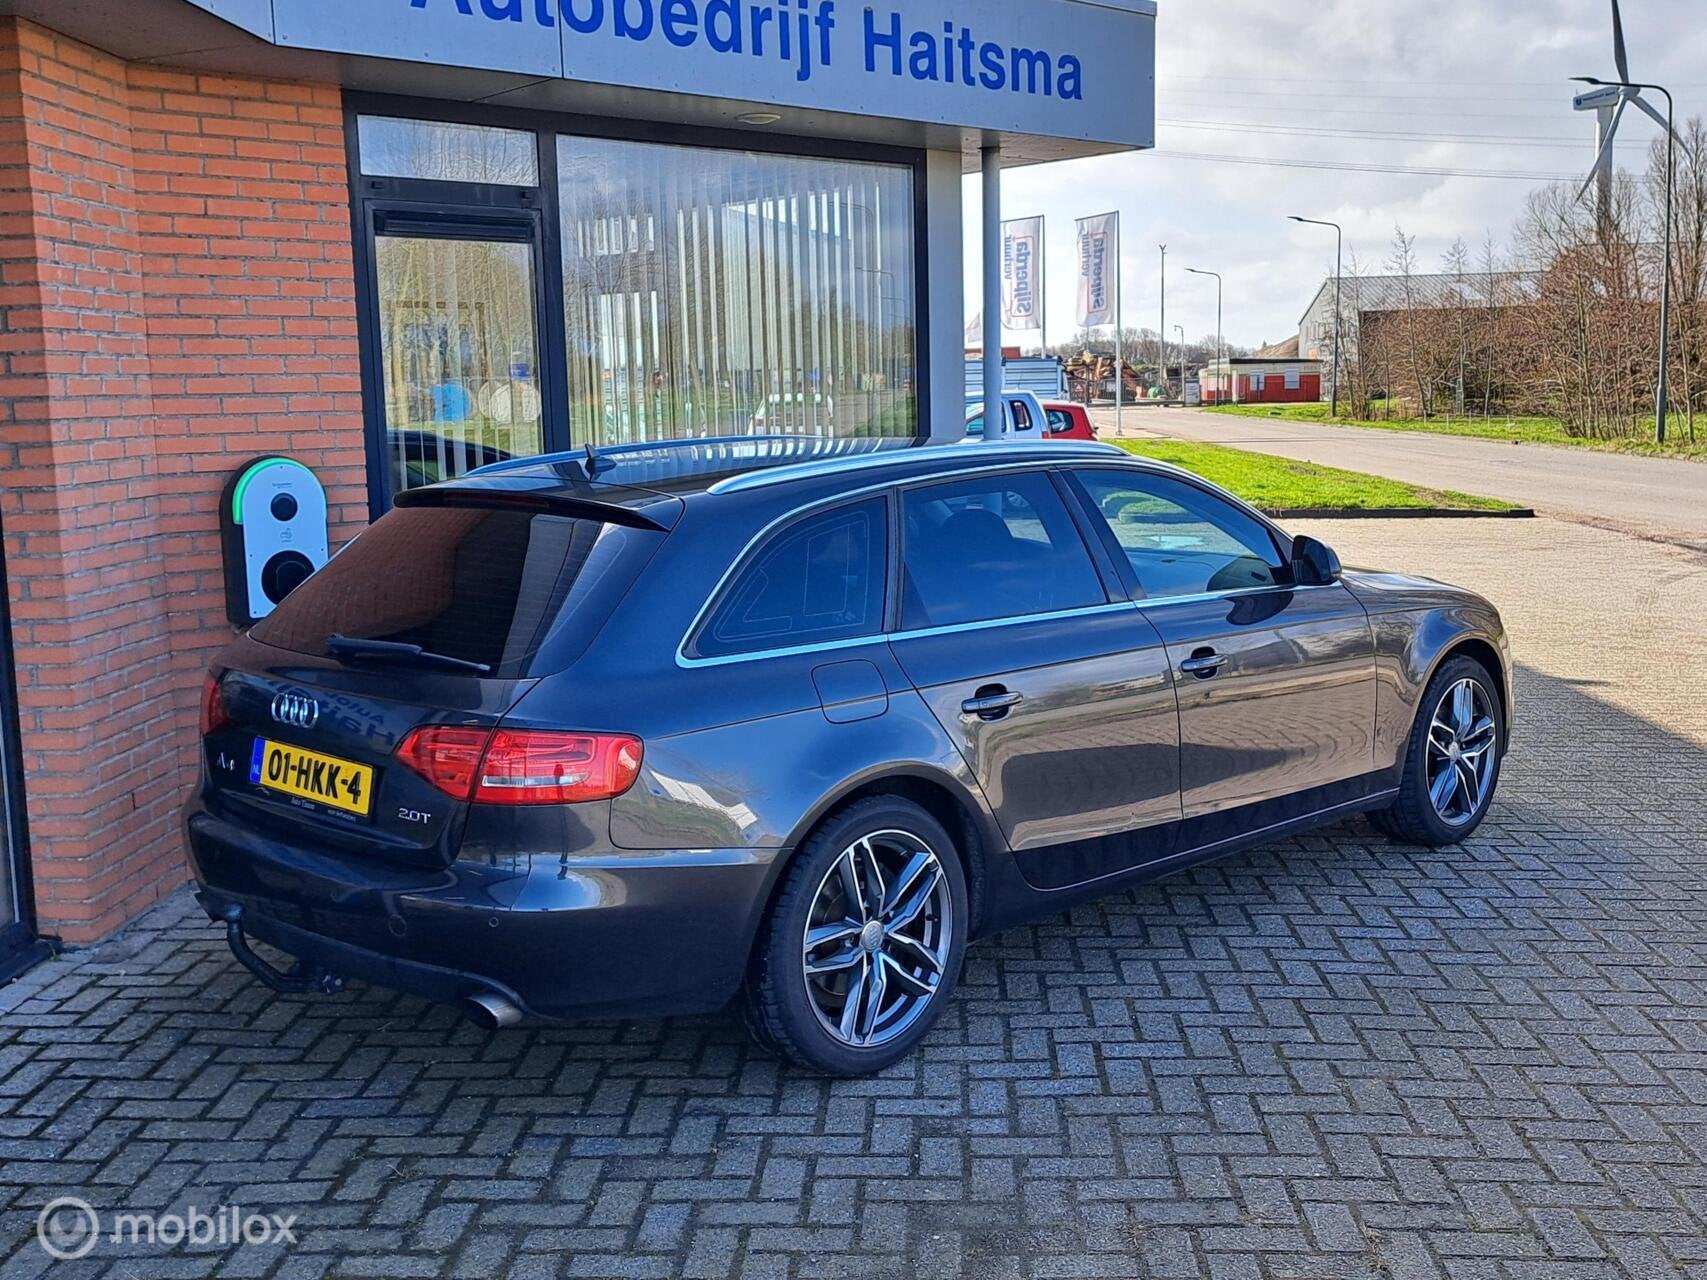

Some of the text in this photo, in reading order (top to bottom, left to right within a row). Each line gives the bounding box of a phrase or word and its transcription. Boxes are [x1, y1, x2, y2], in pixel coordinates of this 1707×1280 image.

[411, 0, 1082, 100] obedrijf Haitsma
[268, 749, 362, 805] 01-HKK-4
